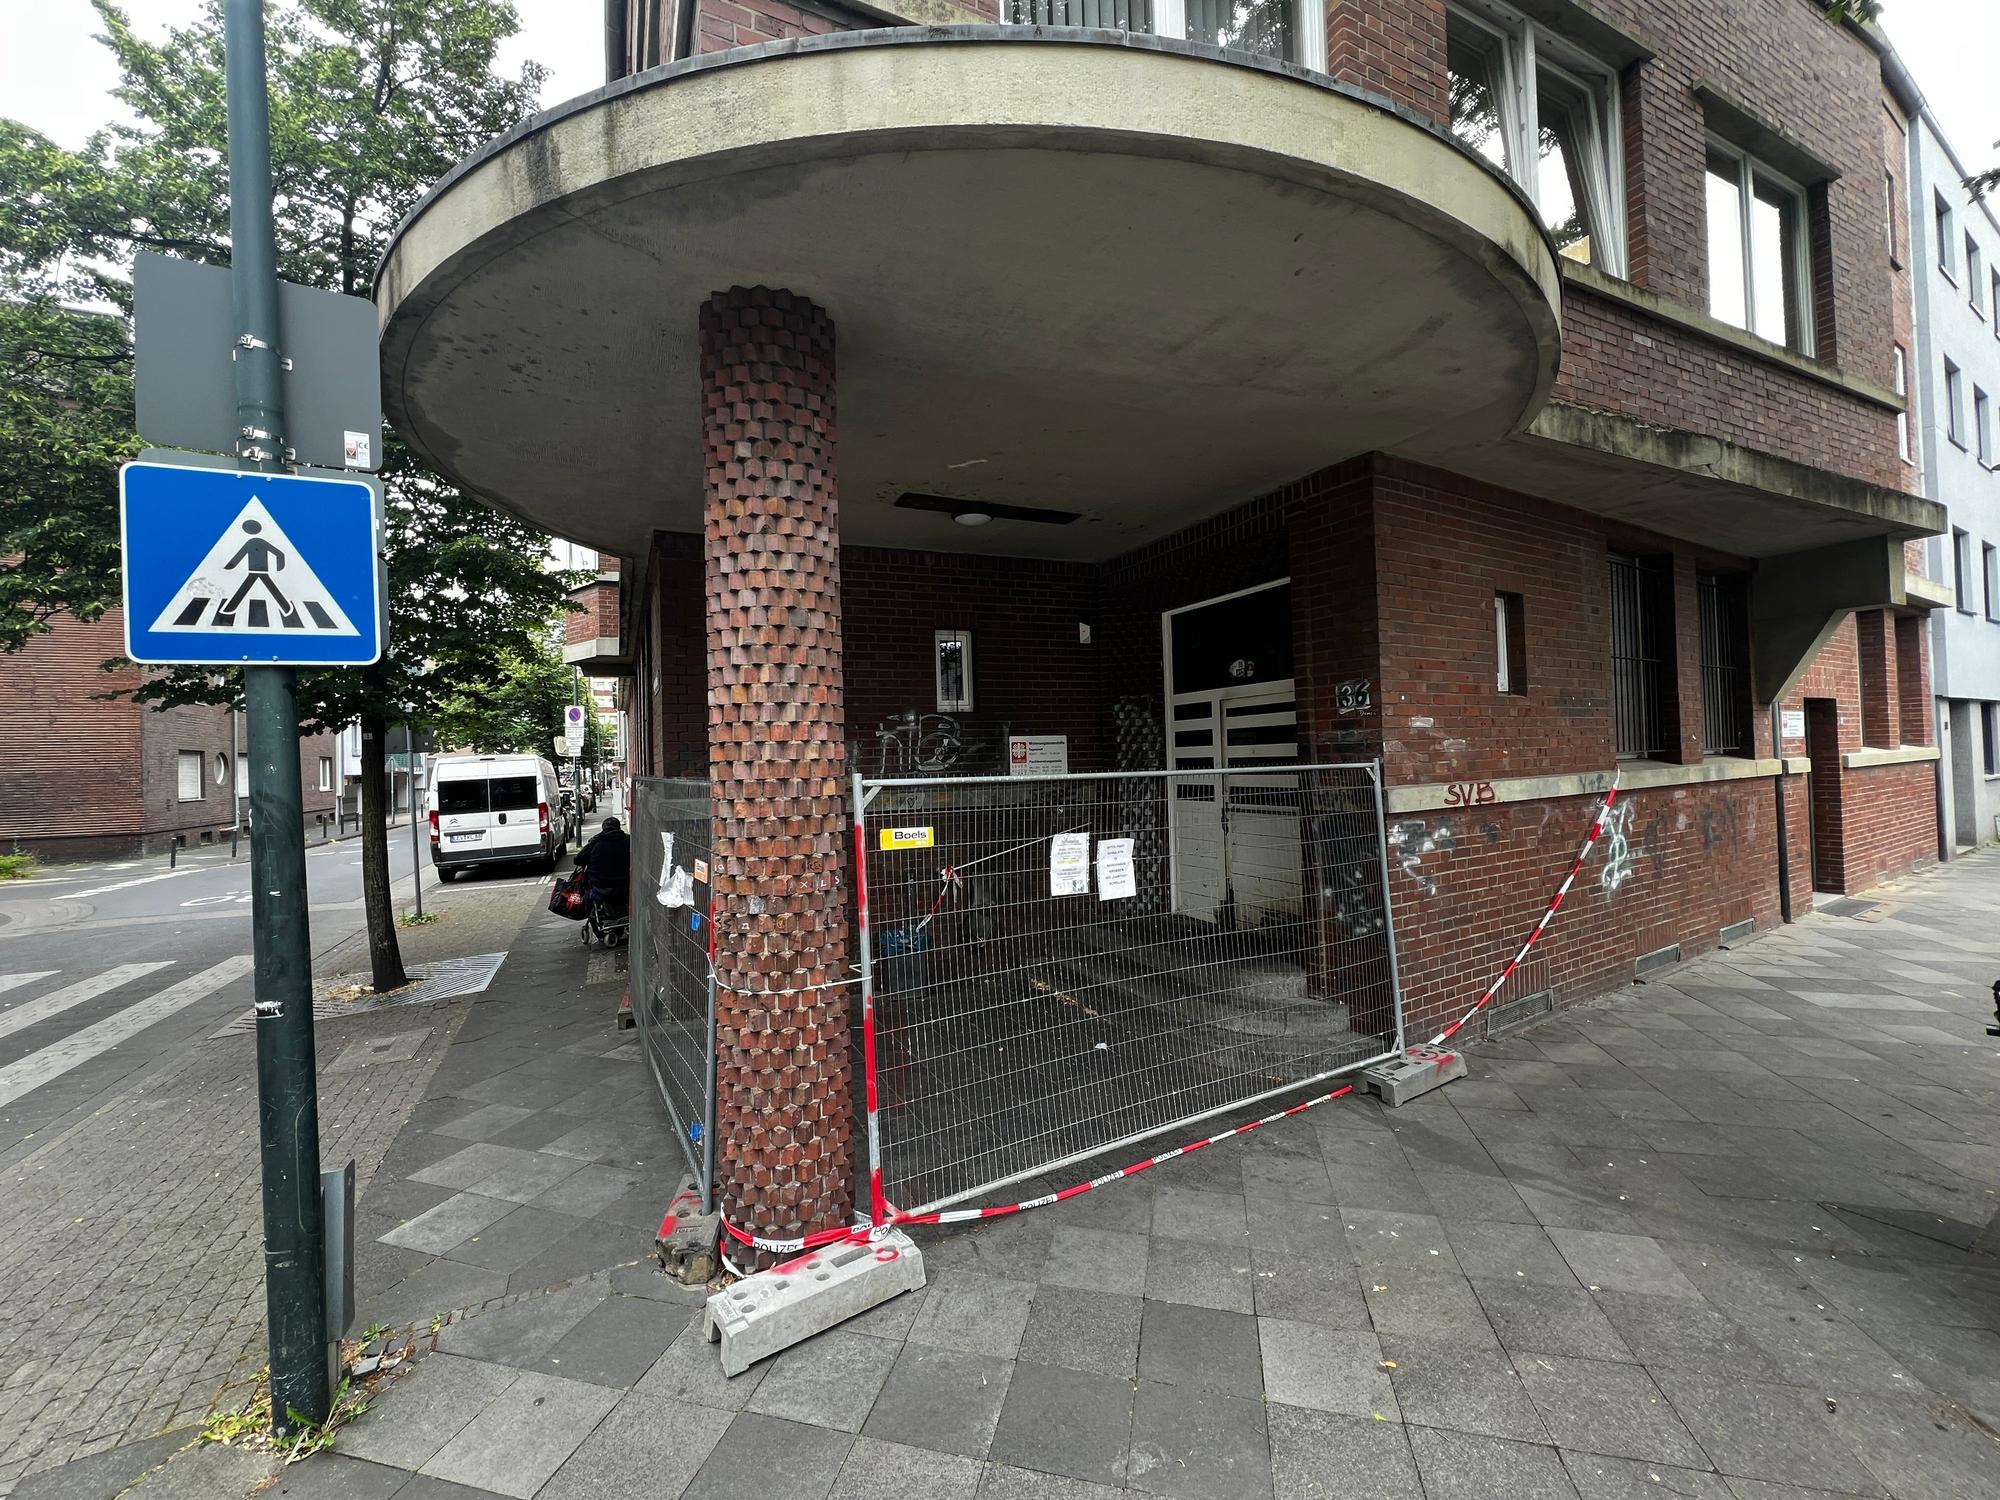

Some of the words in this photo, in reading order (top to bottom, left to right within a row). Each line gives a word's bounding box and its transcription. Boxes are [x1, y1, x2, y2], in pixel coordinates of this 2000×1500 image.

[1337, 680, 1371, 709] 36
[1443, 782, 1496, 807] SVB
[894, 830, 927, 840] Boels
